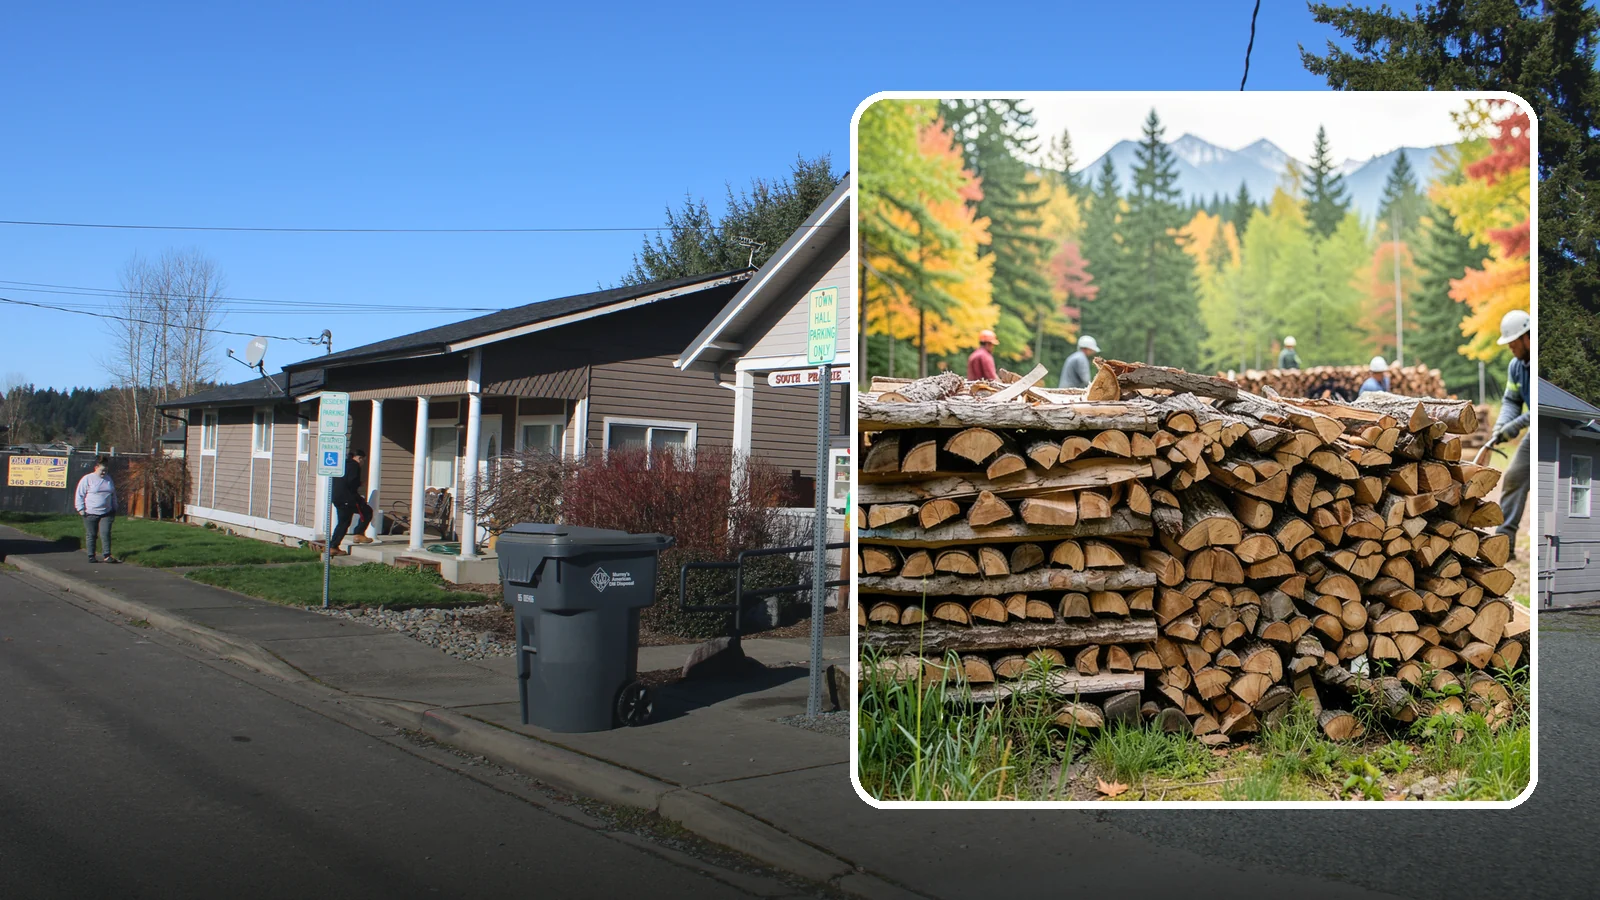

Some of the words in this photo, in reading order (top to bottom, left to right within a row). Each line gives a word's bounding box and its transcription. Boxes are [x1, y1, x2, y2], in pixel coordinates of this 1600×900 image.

[815, 295, 833, 307] TOWN
[814, 311, 831, 324] HALL
[810, 326, 836, 340] PARKING
[813, 344, 831, 357] ONLY
[775, 373, 801, 384] SOUTH
[807, 370, 842, 382] PRRIE
